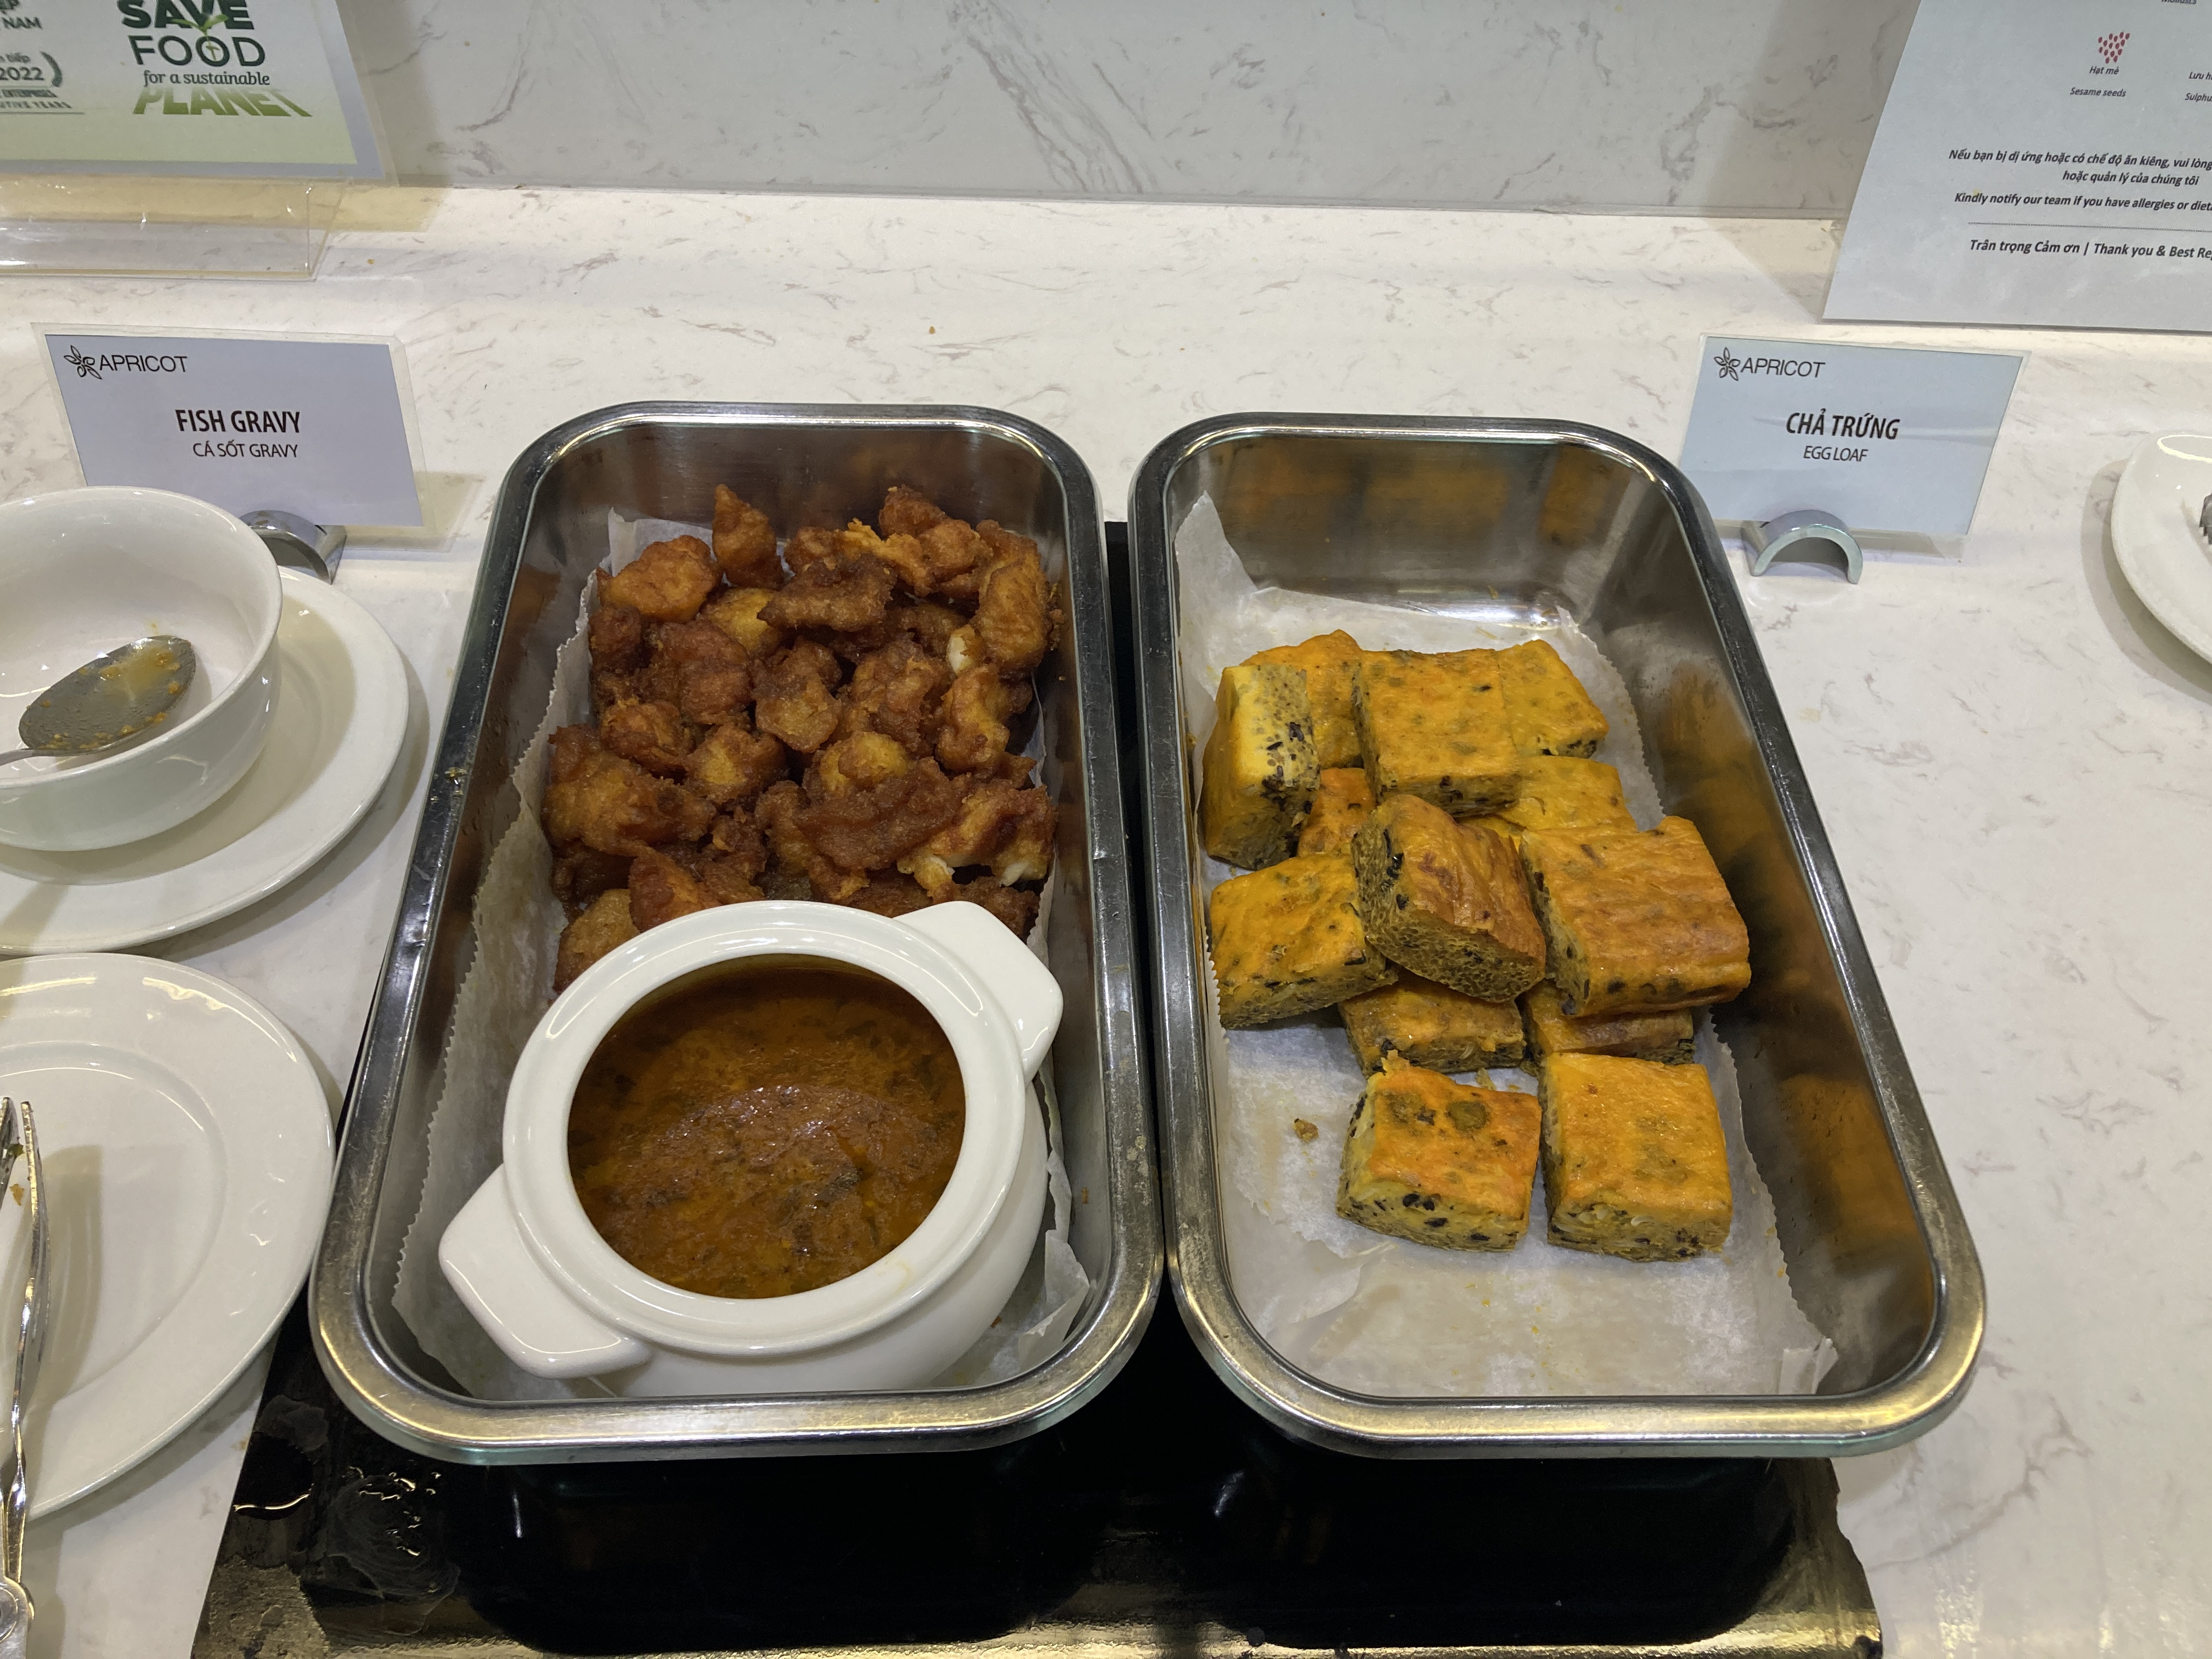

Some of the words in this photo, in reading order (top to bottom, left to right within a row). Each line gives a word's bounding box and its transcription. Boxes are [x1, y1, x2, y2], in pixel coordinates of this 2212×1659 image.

[2, 16, 43, 30] NAM
[117, 0, 255, 30] SAVE
[128, 35, 266, 67] FOOD
[0, 66, 44, 81] 2022
[143, 69, 166, 87] for
[170, 74, 182, 84] a
[183, 71, 271, 86] sustainable
[2070, 87, 2102, 96] Sesame
[2102, 88, 2127, 97] seeds
[2185, 92, 2212, 103] Sulphu
[1949, 148, 1971, 160] Nếu
[1973, 150, 1994, 162] bạn
[1995, 150, 2007, 163] bị
[2008, 151, 2020, 163] dị
[2021, 151, 2043, 164] ứng
[2044, 151, 2071, 165] hoặc
[2072, 153, 2086, 163] có
[2087, 153, 2109, 164] chế
[2108, 154, 2123, 167] độ
[2124, 155, 2137, 165] ăn
[2139, 155, 2170, 169] kiêng,
[2173, 158, 2191, 167] vui
[2191, 157, 2212, 171] lòng
[2062, 170, 2089, 183] hoặc
[2090, 171, 2117, 184] quản
[2118, 172, 2130, 185] lý
[2130, 172, 2149, 183] của
[2151, 173, 2183, 187] chúng
[2184, 175, 2200, 185] tôi
[1954, 192, 1989, 205] Kindly
[1989, 193, 2022, 206] notify
[2044, 196, 2072, 205] team
[2073, 195, 2083, 206] if
[2083, 198, 2103, 208] you
[2104, 196, 2131, 207] have
[2132, 198, 2176, 211] allergies
[1971, 239, 1996, 251] Trân
[1999, 241, 2033, 255] trọng
[2034, 240, 2061, 253] Cảm
[2063, 244, 2080, 253] ơn
[2094, 242, 2130, 255] Thank
[2131, 247, 2154, 258] you
[2156, 245, 2166, 256] &
[2169, 246, 2195, 258] Best
[2197, 247, 2212, 261] Re
[99, 354, 188, 373] APRICOT
[1740, 357, 1826, 379] APRICOT
[174, 409, 227, 433] FISH
[230, 410, 301, 433] GRAVY
[1786, 408, 1826, 436] CHẢ
[1831, 412, 1901, 441] TRỨNG
[193, 440, 216, 458] CÁ
[217, 439, 245, 458] SỐT
[249, 443, 299, 458] GRAVY
[1803, 445, 1832, 460] EGG
[1833, 447, 1869, 462] LOAF
